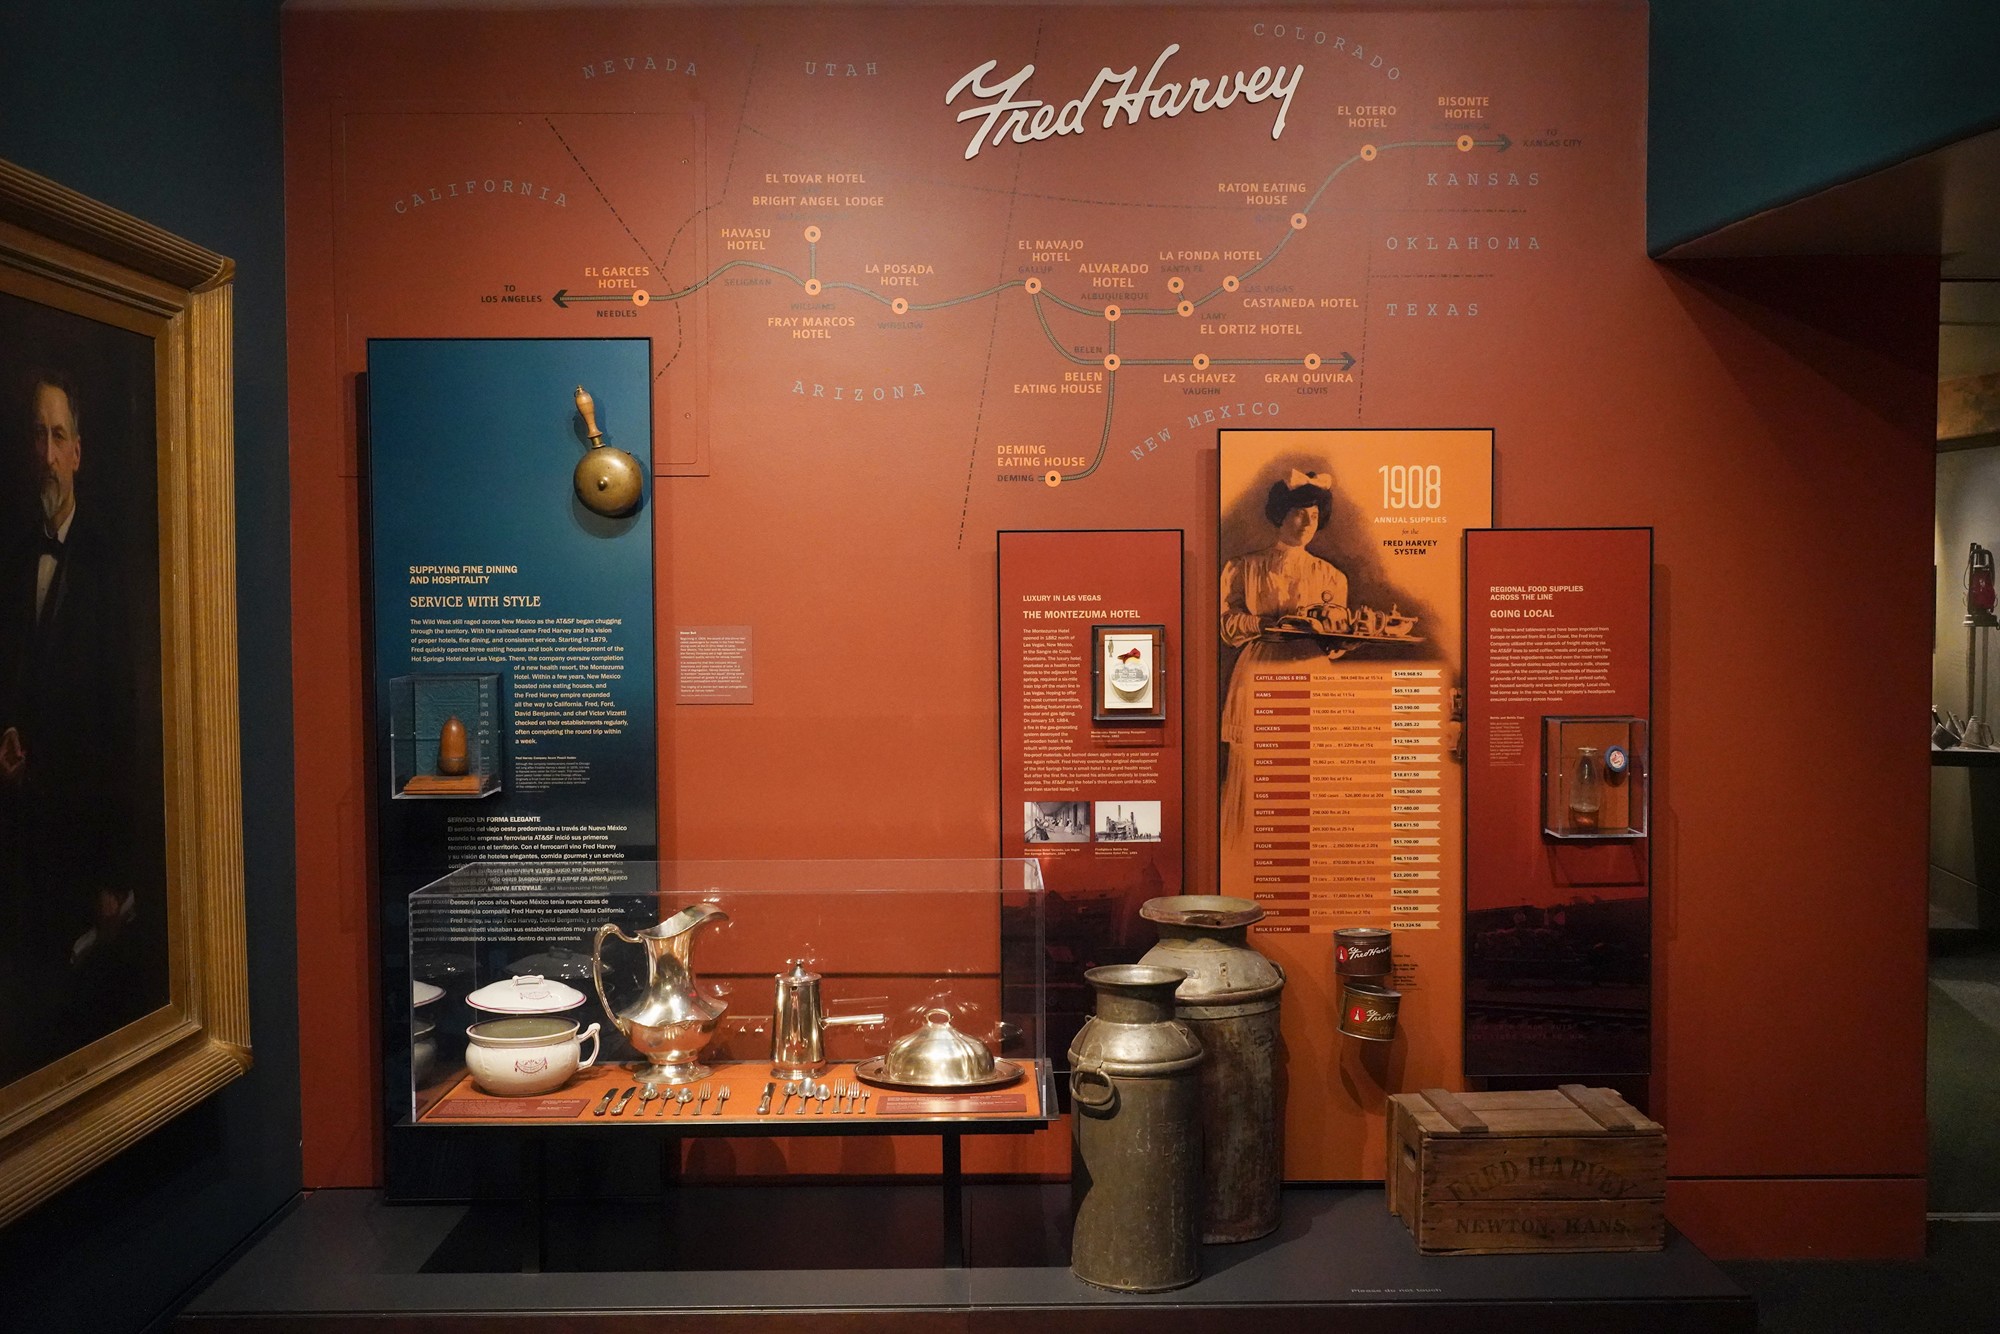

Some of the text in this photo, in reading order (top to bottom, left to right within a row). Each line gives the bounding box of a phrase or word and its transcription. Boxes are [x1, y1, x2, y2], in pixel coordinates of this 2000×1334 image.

[1252, 22, 1401, 80] COLORADO
[582, 56, 700, 80] NEVADA
[804, 61, 880, 77] UTAH
[945, 43, 1305, 160] Fred Harvey
[1438, 97, 1488, 106] BISONTE
[1338, 106, 1396, 115] EL OTERO
[1445, 109, 1483, 118] HOTEL
[1349, 118, 1387, 127] HOTEL
[766, 174, 866, 183] EL TOVAR HOTEL
[1427, 172, 1541, 187] KANSAS
[1219, 183, 1306, 192] RATON EATING
[393, 179, 569, 214] CALIFORNIA
[1247, 196, 1287, 204] HOUSE
[753, 197, 883, 206] BRIGHT ANGEL LODGE
[722, 229, 770, 238] HAVASU
[728, 241, 766, 250] HOTEL
[1018, 240, 1084, 251] EL NAVAJO
[1386, 235, 1541, 251] OKLAHOMA
[1033, 253, 1070, 262] HOTEL
[1160, 251, 1262, 260] LA FONDA HOTEL
[586, 267, 649, 276] EL GARCES
[866, 264, 934, 274] LA POSADA
[1079, 264, 1148, 273] ALVARADO
[599, 279, 637, 288] HOTEL
[881, 277, 918, 286] HOTEL
[1093, 278, 1134, 287] HOTEL
[504, 284, 516, 293] TO
[1080, 292, 1150, 302] ALBUQUERQUE
[1244, 298, 1358, 308] CASTANEDA HOTEL
[1386, 302, 1480, 317] TEXAS
[768, 317, 855, 326] FRAY MARCOS
[1201, 324, 1302, 334] EL ORTIZ HOTEL
[793, 330, 831, 338] HOTEL
[1074, 345, 1102, 354] BELEN
[1065, 372, 1102, 381] BELEN
[1164, 374, 1235, 382] LAS CHAVEZ
[1265, 374, 1353, 384] GRAN QUIVIRA
[793, 380, 925, 401] ARIZONA
[1014, 384, 1101, 393] EATING HOUSE
[1131, 403, 1281, 461] NEW MEXICO
[998, 445, 1045, 454] DEMING
[997, 454, 1084, 466] EATING HOUSE
[1378, 465, 1441, 509] 1908
[410, 596, 541, 607] SERVICE WITH STYLE
[1348, 946, 1370, 961] Fred
[1366, 1009, 1389, 1024] Fred
[1446, 1156, 1638, 1208] FRED HARVEY
[1456, 1217, 1633, 1234] NEWTON, KANS.
